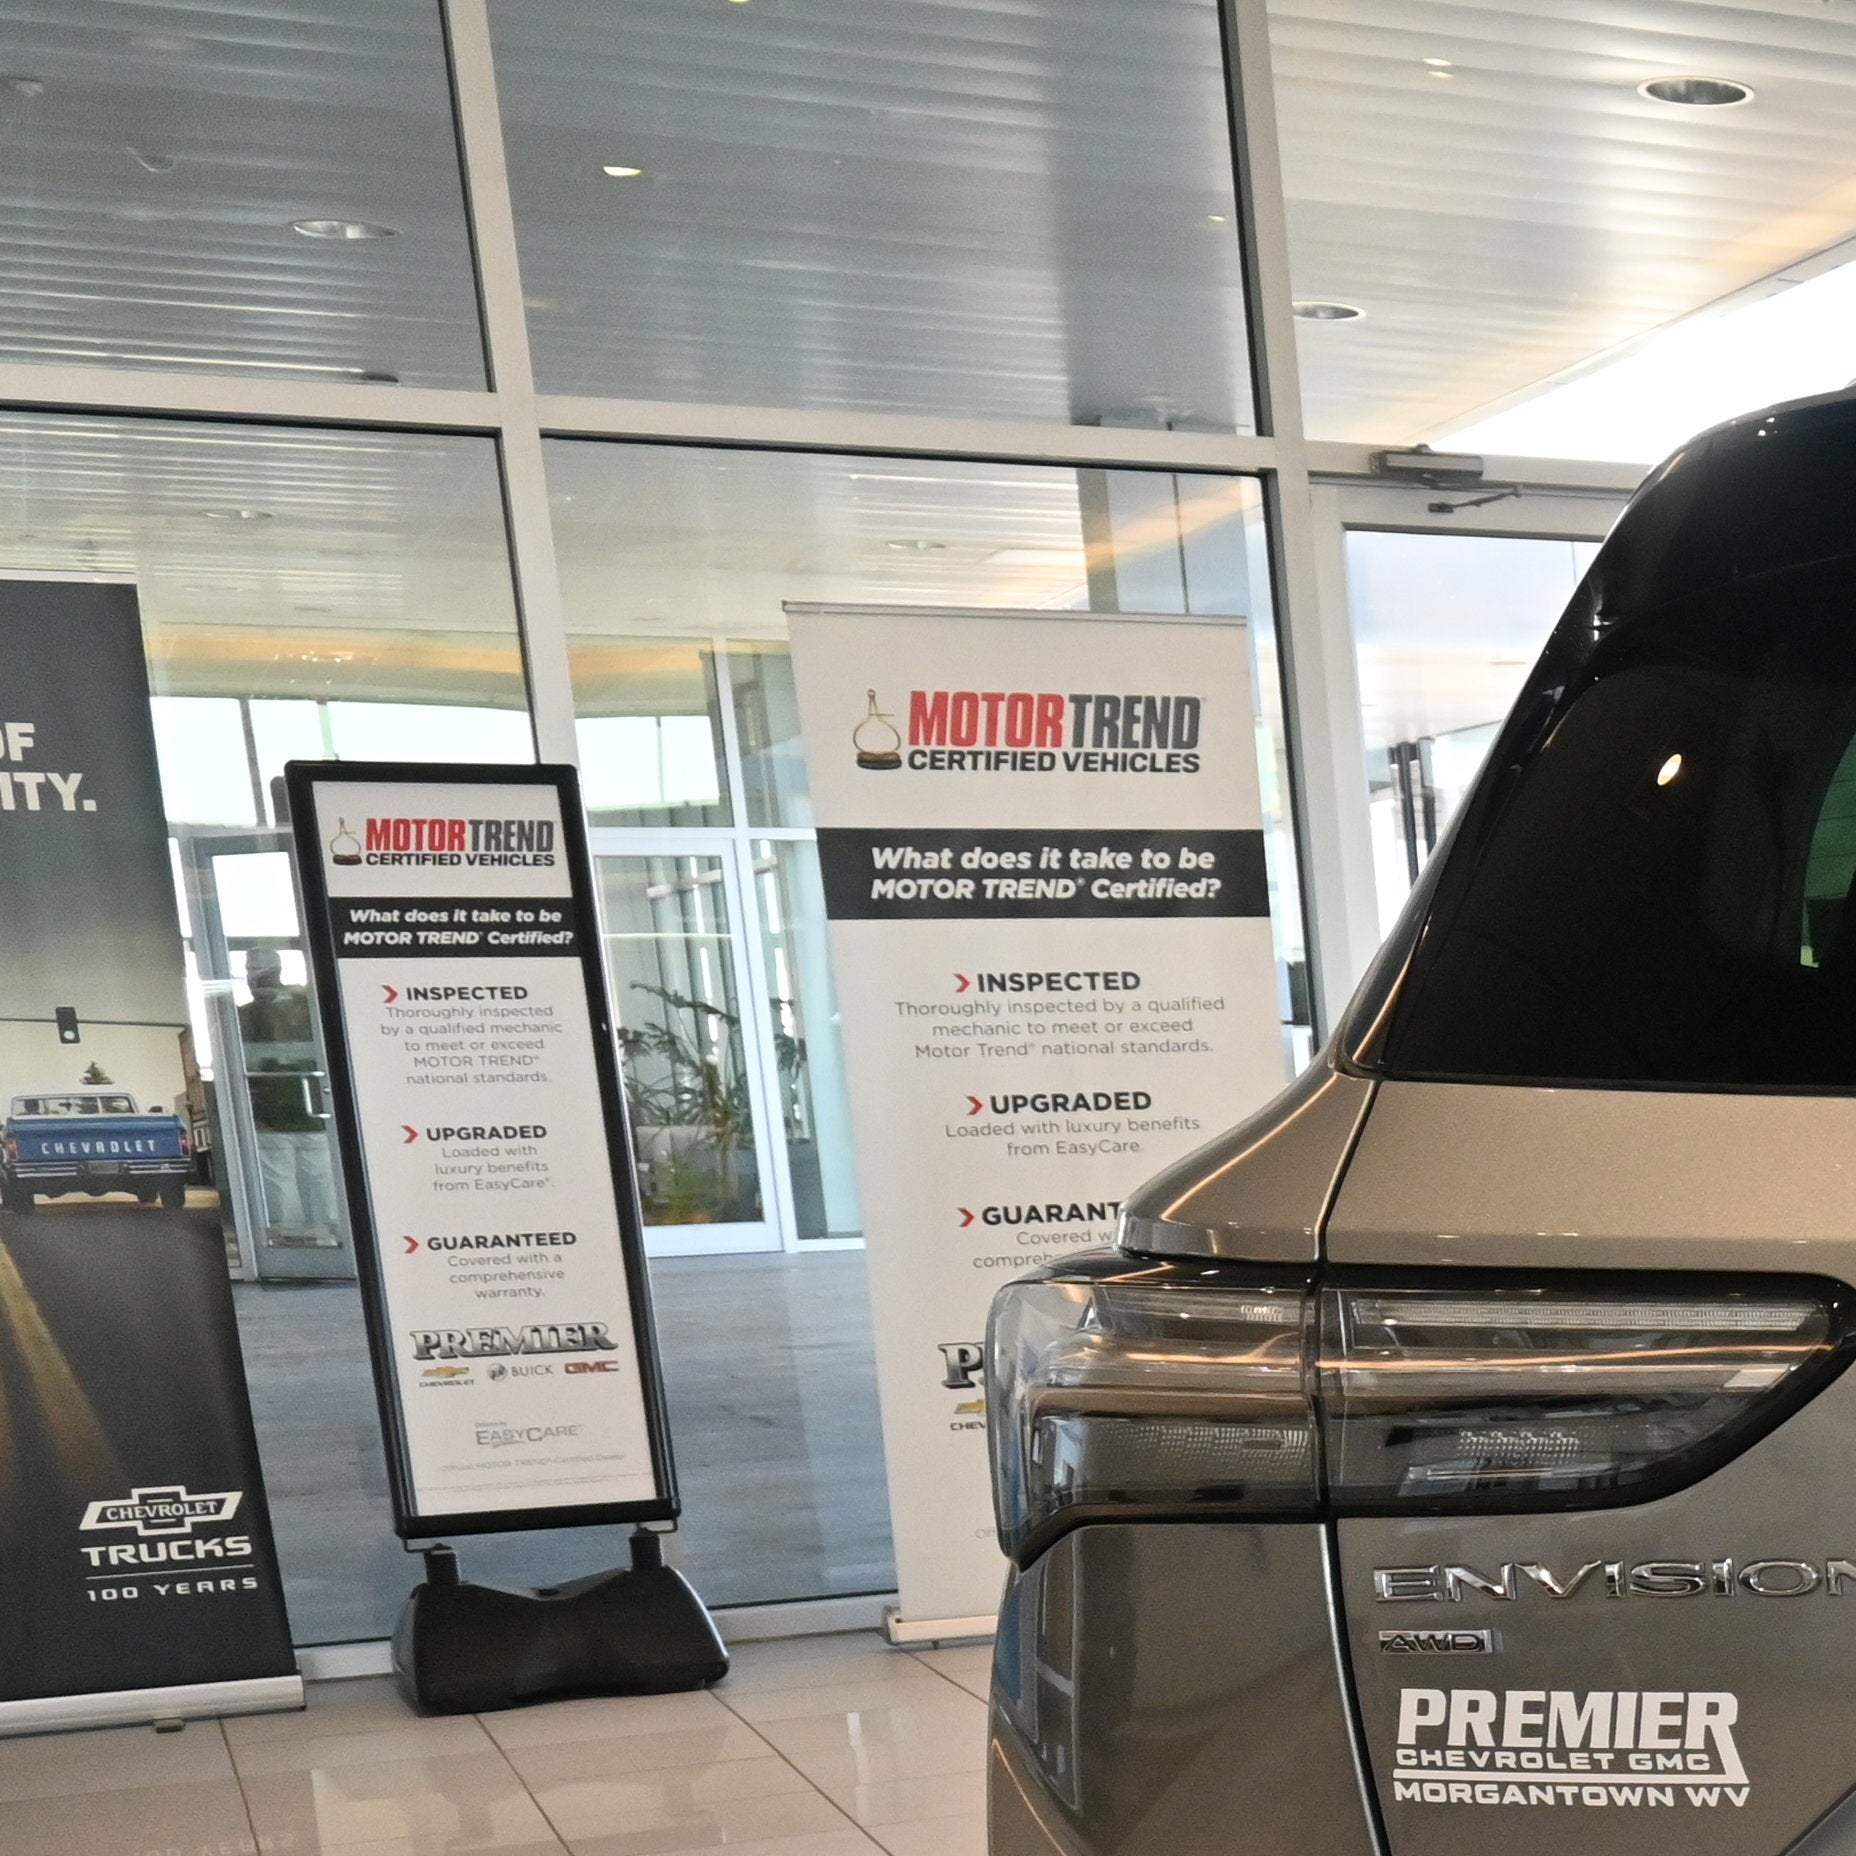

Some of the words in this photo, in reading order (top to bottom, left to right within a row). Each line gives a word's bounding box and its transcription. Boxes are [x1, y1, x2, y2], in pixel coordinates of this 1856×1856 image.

[0, 722, 35, 761] F
[907, 749, 1057, 772] CERTIFIED
[1061, 751, 1200, 774] VEHICLES
[366, 853, 462, 866] CERTIFIED
[465, 854, 555, 867] VEHICLES
[871, 845, 952, 870] What
[960, 846, 1032, 869] does
[1039, 845, 1062, 869] it
[1069, 846, 1133, 869] take
[1140, 848, 1171, 869] to
[1178, 846, 1215, 869] be
[870, 878, 976, 900] MOTOR
[1090, 878, 1222, 900] Certified?
[350, 909, 400, 923] What
[404, 909, 448, 923] does
[453, 909, 467, 923] it
[472, 909, 511, 923] take
[516, 910, 534, 923] to
[539, 909, 562, 923] be
[344, 932, 412, 945] MOTOR
[487, 931, 574, 945] Certified?
[976, 971, 1141, 993] INSPECTED
[406, 986, 528, 1001] INSPECTED
[387, 1006, 474, 1020] Thoroughly
[479, 1005, 553, 1019] inspected
[894, 1000, 1002, 1017] Thoroughly
[1007, 999, 1098, 1016] inspected
[1103, 998, 1125, 1014] by
[1131, 1001, 1143, 1012] a
[1147, 997, 1225, 1014] qualified
[380, 1023, 400, 1037] by
[405, 1026, 414, 1036] a
[419, 1021, 485, 1037] qualified
[490, 1021, 562, 1034] mechanic
[932, 1021, 1022, 1037] mechanic
[1026, 1022, 1047, 1036] to
[1051, 1021, 1099, 1035] meet
[1104, 1022, 1124, 1034] or
[1129, 1018, 1193, 1034] exceed
[405, 1040, 420, 1052] to
[425, 1040, 464, 1051] meet
[470, 1041, 485, 1050] or
[491, 1038, 545, 1050] exceed
[915, 1043, 970, 1059] Motor
[1041, 1040, 1114, 1056] national
[1120, 1038, 1214, 1055] standards.
[414, 1056, 473, 1068] MOTOR
[406, 1071, 468, 1085] national
[990, 1091, 1152, 1115] UPGRADED
[426, 1125, 547, 1141] UPGRADED
[945, 1121, 1015, 1139] Loaded
[1021, 1120, 1060, 1136] with
[1065, 1118, 1122, 1136] luxury
[1127, 1116, 1200, 1132] benefits
[441, 1146, 500, 1159] Loaded
[505, 1145, 538, 1157] with
[1007, 1141, 1050, 1157] from
[1055, 1138, 1144, 1156] EasyCare.
[434, 1162, 483, 1177] luxury
[488, 1161, 549, 1174] benefits
[433, 1180, 470, 1192] from
[981, 1201, 1122, 1226] GUARANT
[427, 1232, 576, 1251] GUARANTEED
[1016, 1228, 1092, 1246] Covered
[448, 1253, 512, 1268] Covered
[516, 1252, 549, 1265] with
[972, 1251, 1054, 1270] compreh
[449, 1268, 565, 1284] comprehensive
[475, 1286, 545, 1300] warranty.
[409, 1321, 618, 1361] PREMIER
[510, 1363, 554, 1378] BUICK
[564, 1360, 620, 1375] GMC
[418, 1379, 475, 1388] CHEVROLET
[106, 1501, 218, 1521] CHEVROLET
[80, 1535, 252, 1567] TRUCKS
[87, 1586, 139, 1602] 100
[152, 1577, 258, 1596] YEARS
[1382, 1631, 1488, 1654] AWD
[1397, 1688, 1749, 1783] PREMIER
[1395, 1748, 1614, 1770] CHEVROLET
[1628, 1751, 1710, 1772] GMC
[1393, 1782, 1674, 1806] MORGANTOWN
[1684, 1785, 1750, 1807] WV
